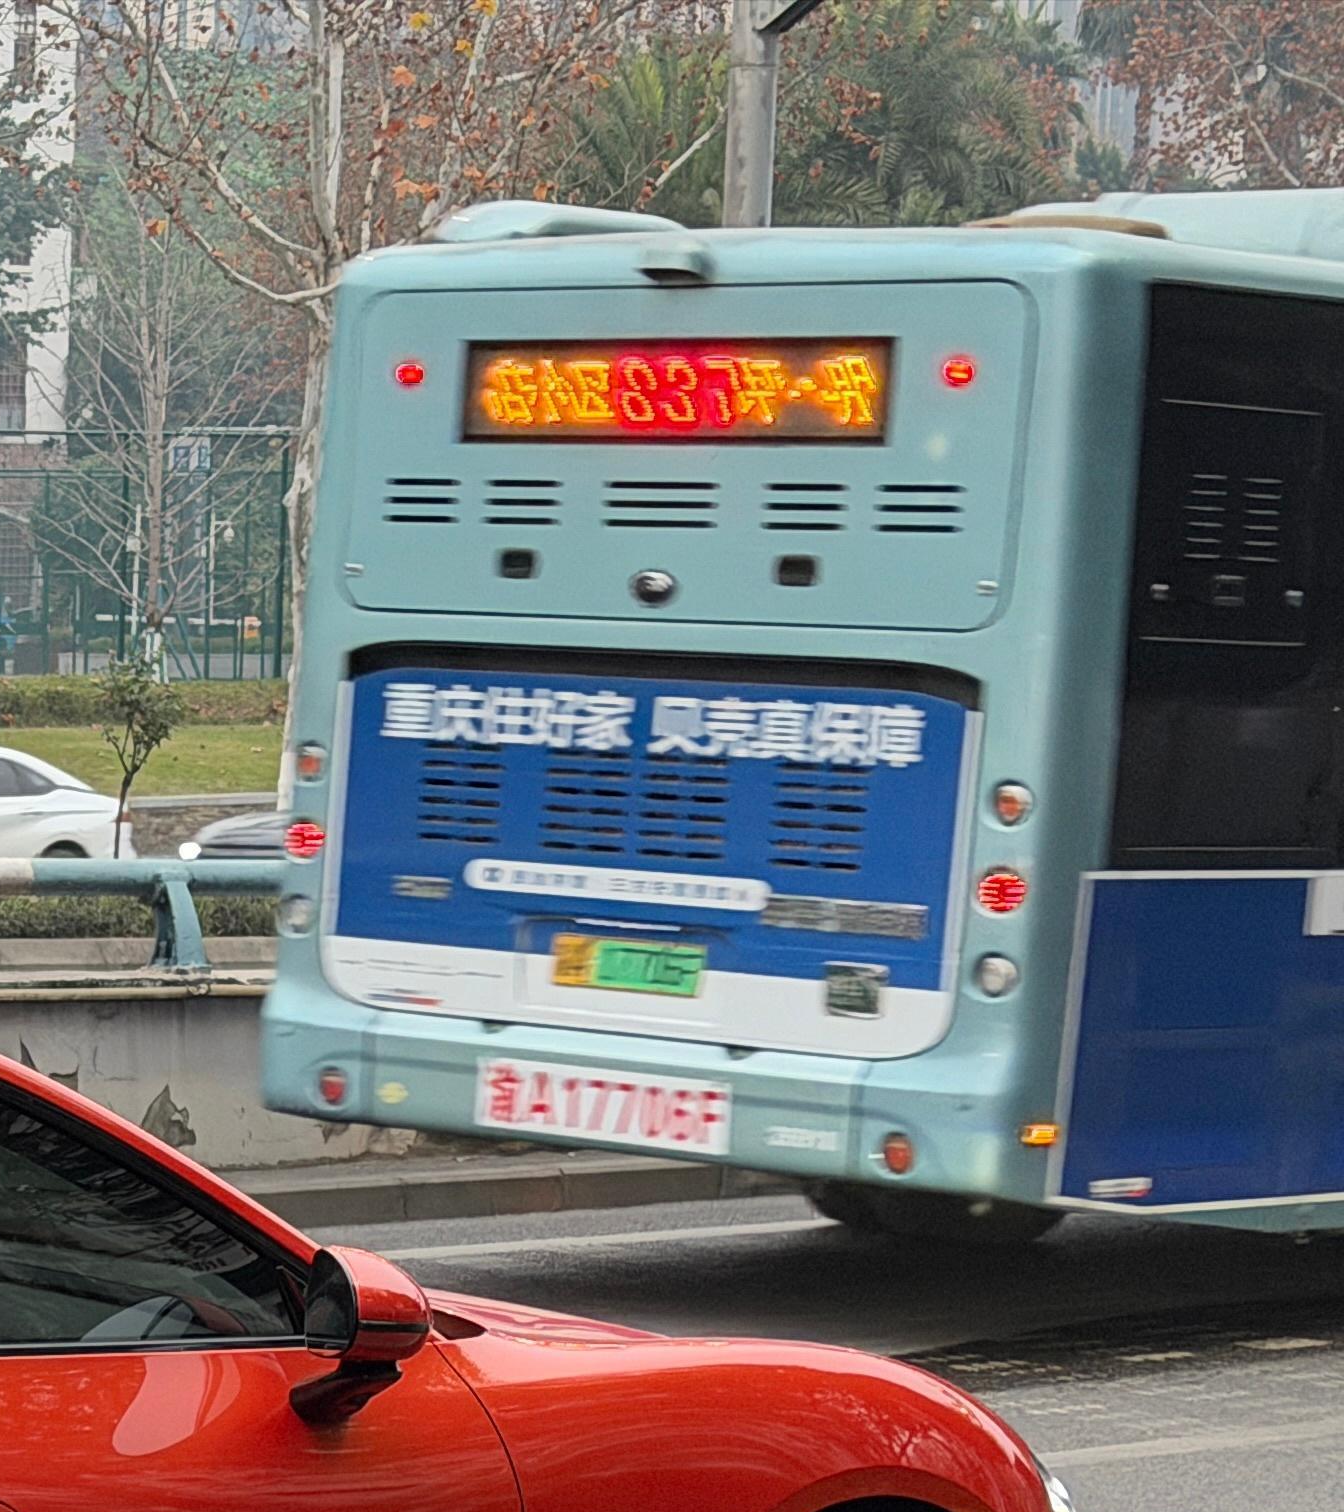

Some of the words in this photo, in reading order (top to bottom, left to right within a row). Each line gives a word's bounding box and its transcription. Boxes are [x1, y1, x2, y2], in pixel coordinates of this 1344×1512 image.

[380, 682, 636, 749] 重庆住好家
[646, 696, 927, 768] 贝壳真保障
